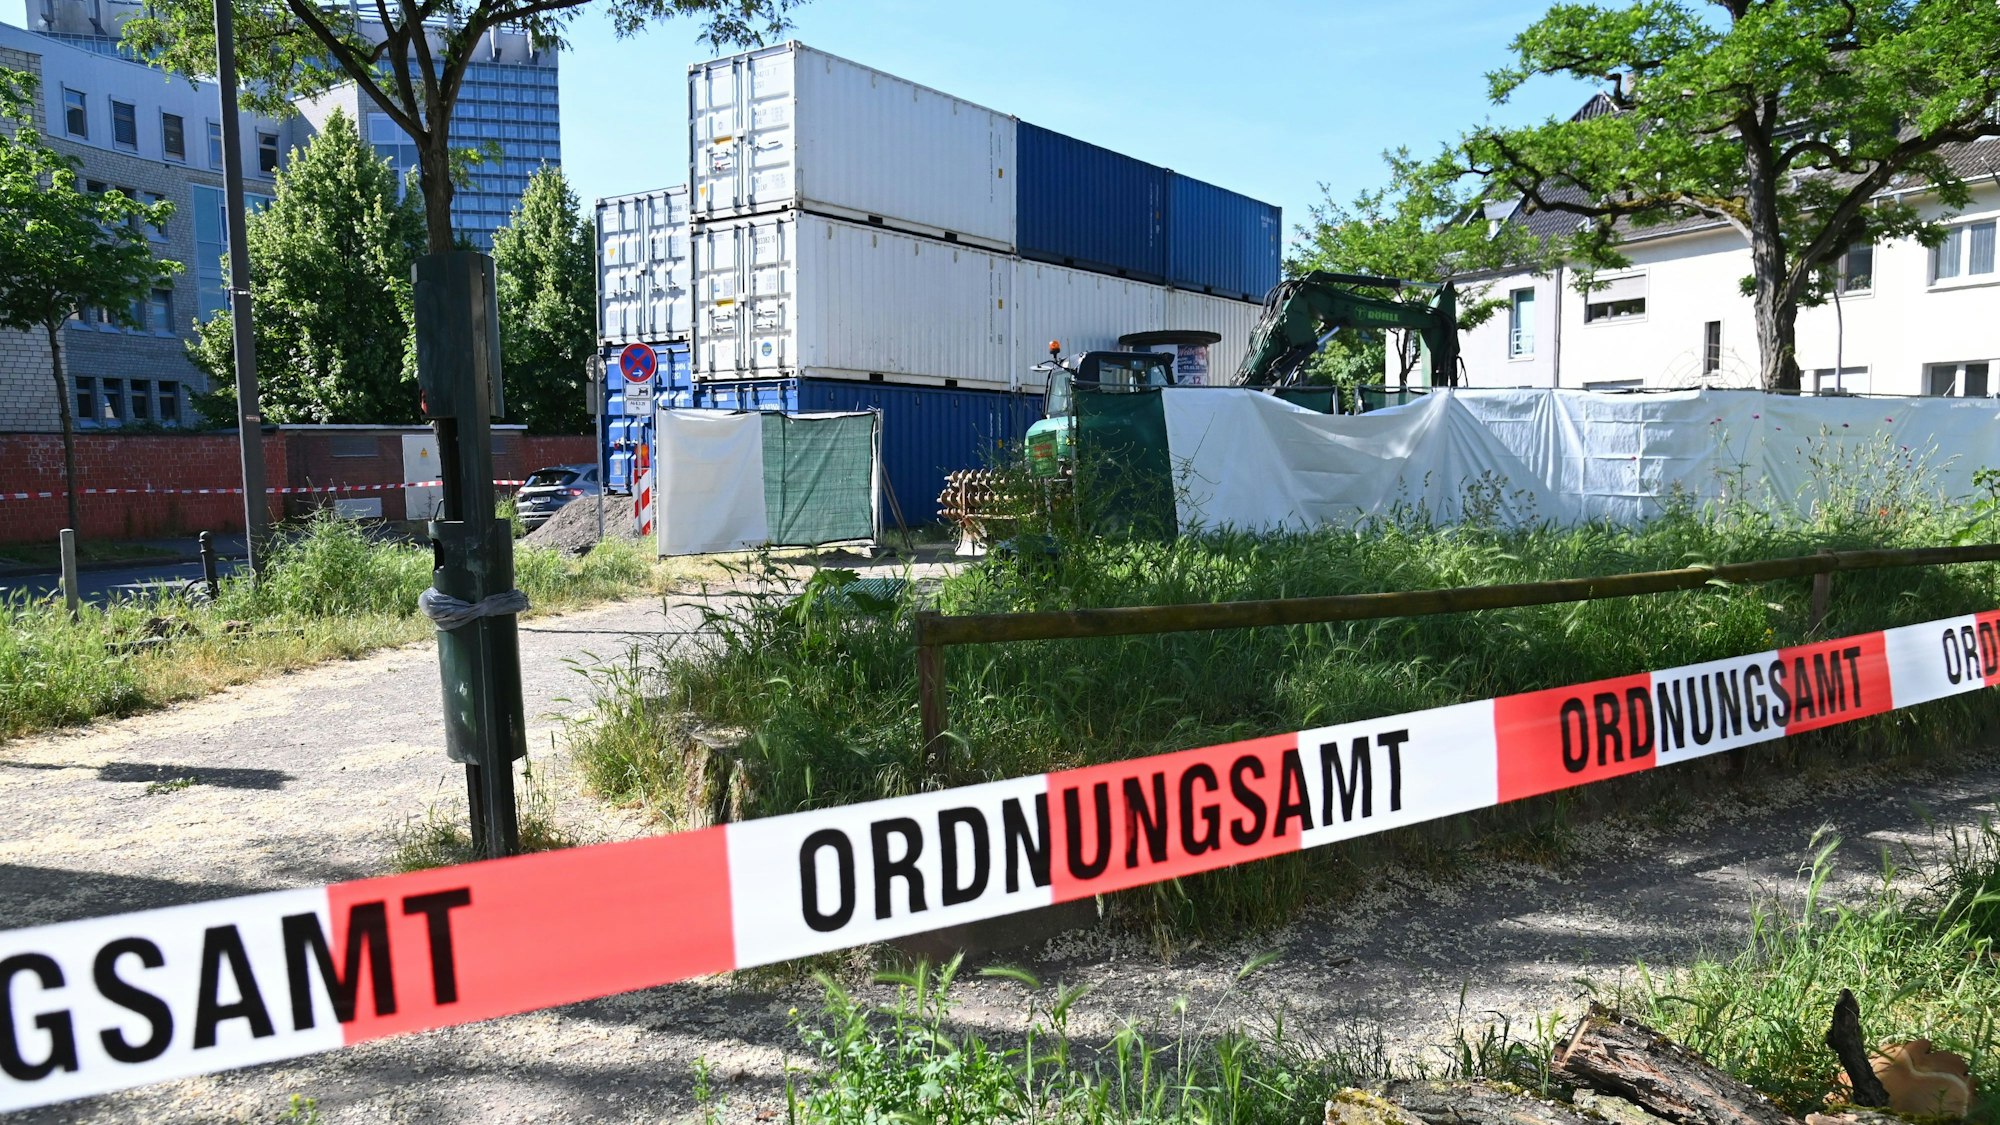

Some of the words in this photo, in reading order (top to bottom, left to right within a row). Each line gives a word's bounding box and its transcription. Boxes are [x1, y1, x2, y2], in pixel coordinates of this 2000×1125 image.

[1560, 646, 1862, 773] ORDNUNGSAMT
[1943, 619, 2000, 685] ORD
[800, 729, 1409, 932] ORDNUNGSAMT
[0, 886, 471, 1081] GSAMT
